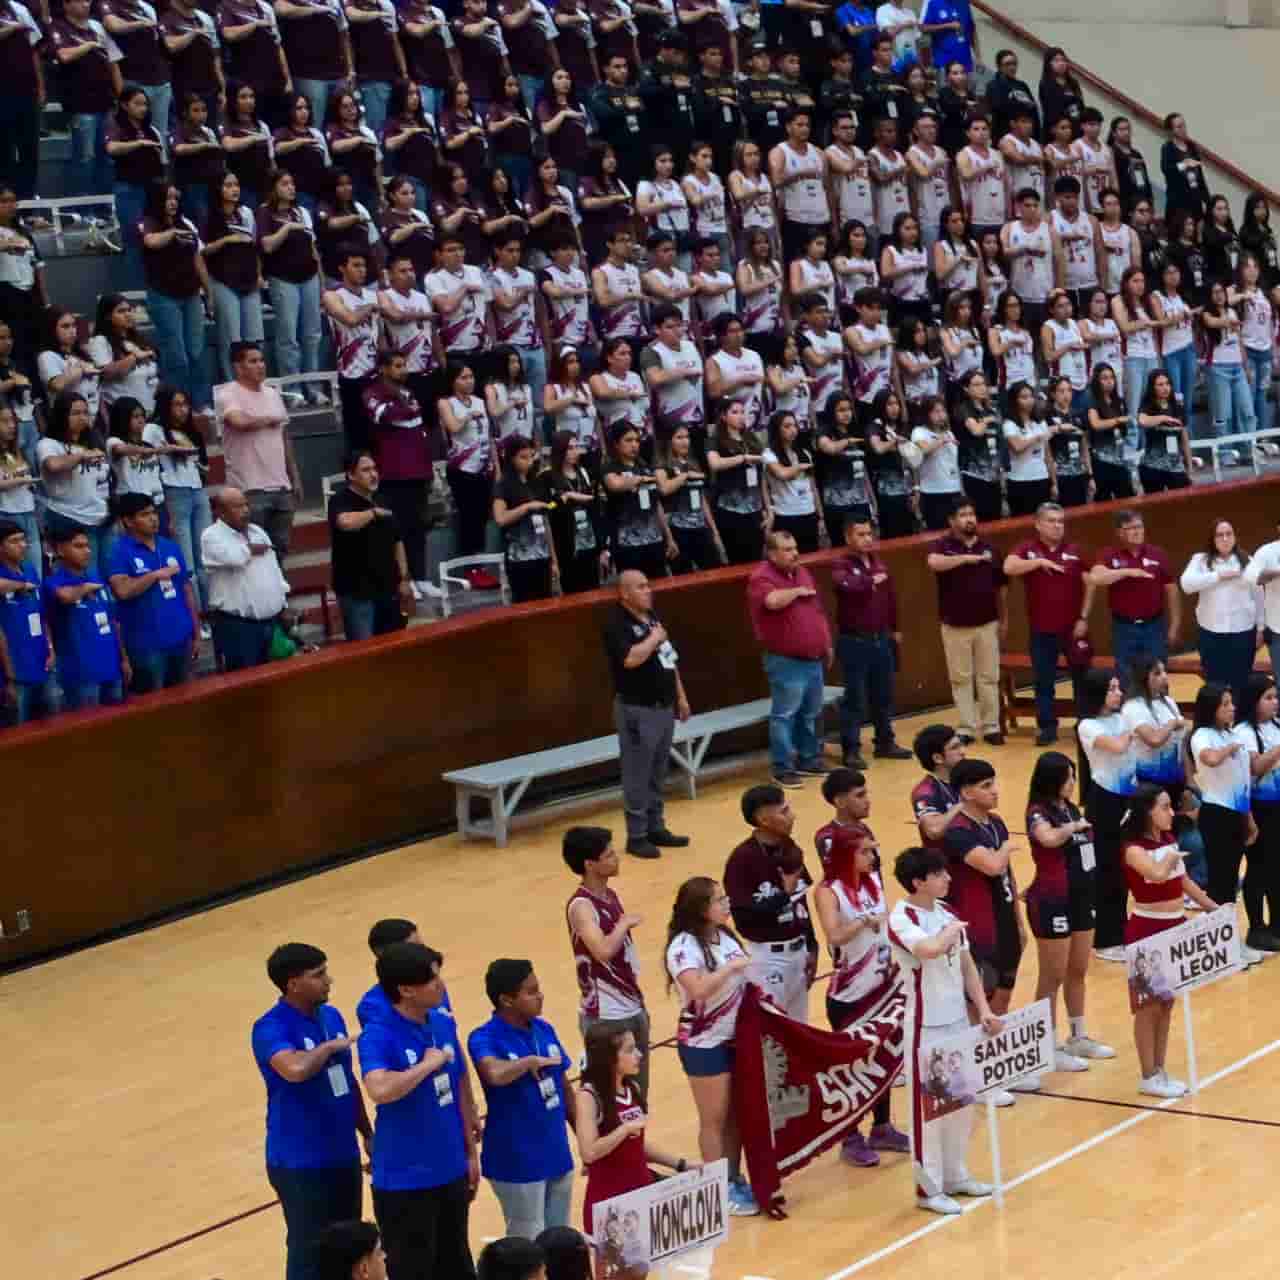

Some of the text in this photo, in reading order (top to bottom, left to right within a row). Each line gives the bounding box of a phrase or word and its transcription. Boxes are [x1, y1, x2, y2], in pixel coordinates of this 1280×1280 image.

[1169, 924, 1233, 963] NUEVO
[974, 1019, 1046, 1064] SAN LUIS
[815, 1057, 889, 1122] SAN
[649, 1182, 723, 1257] MONCLOVA
